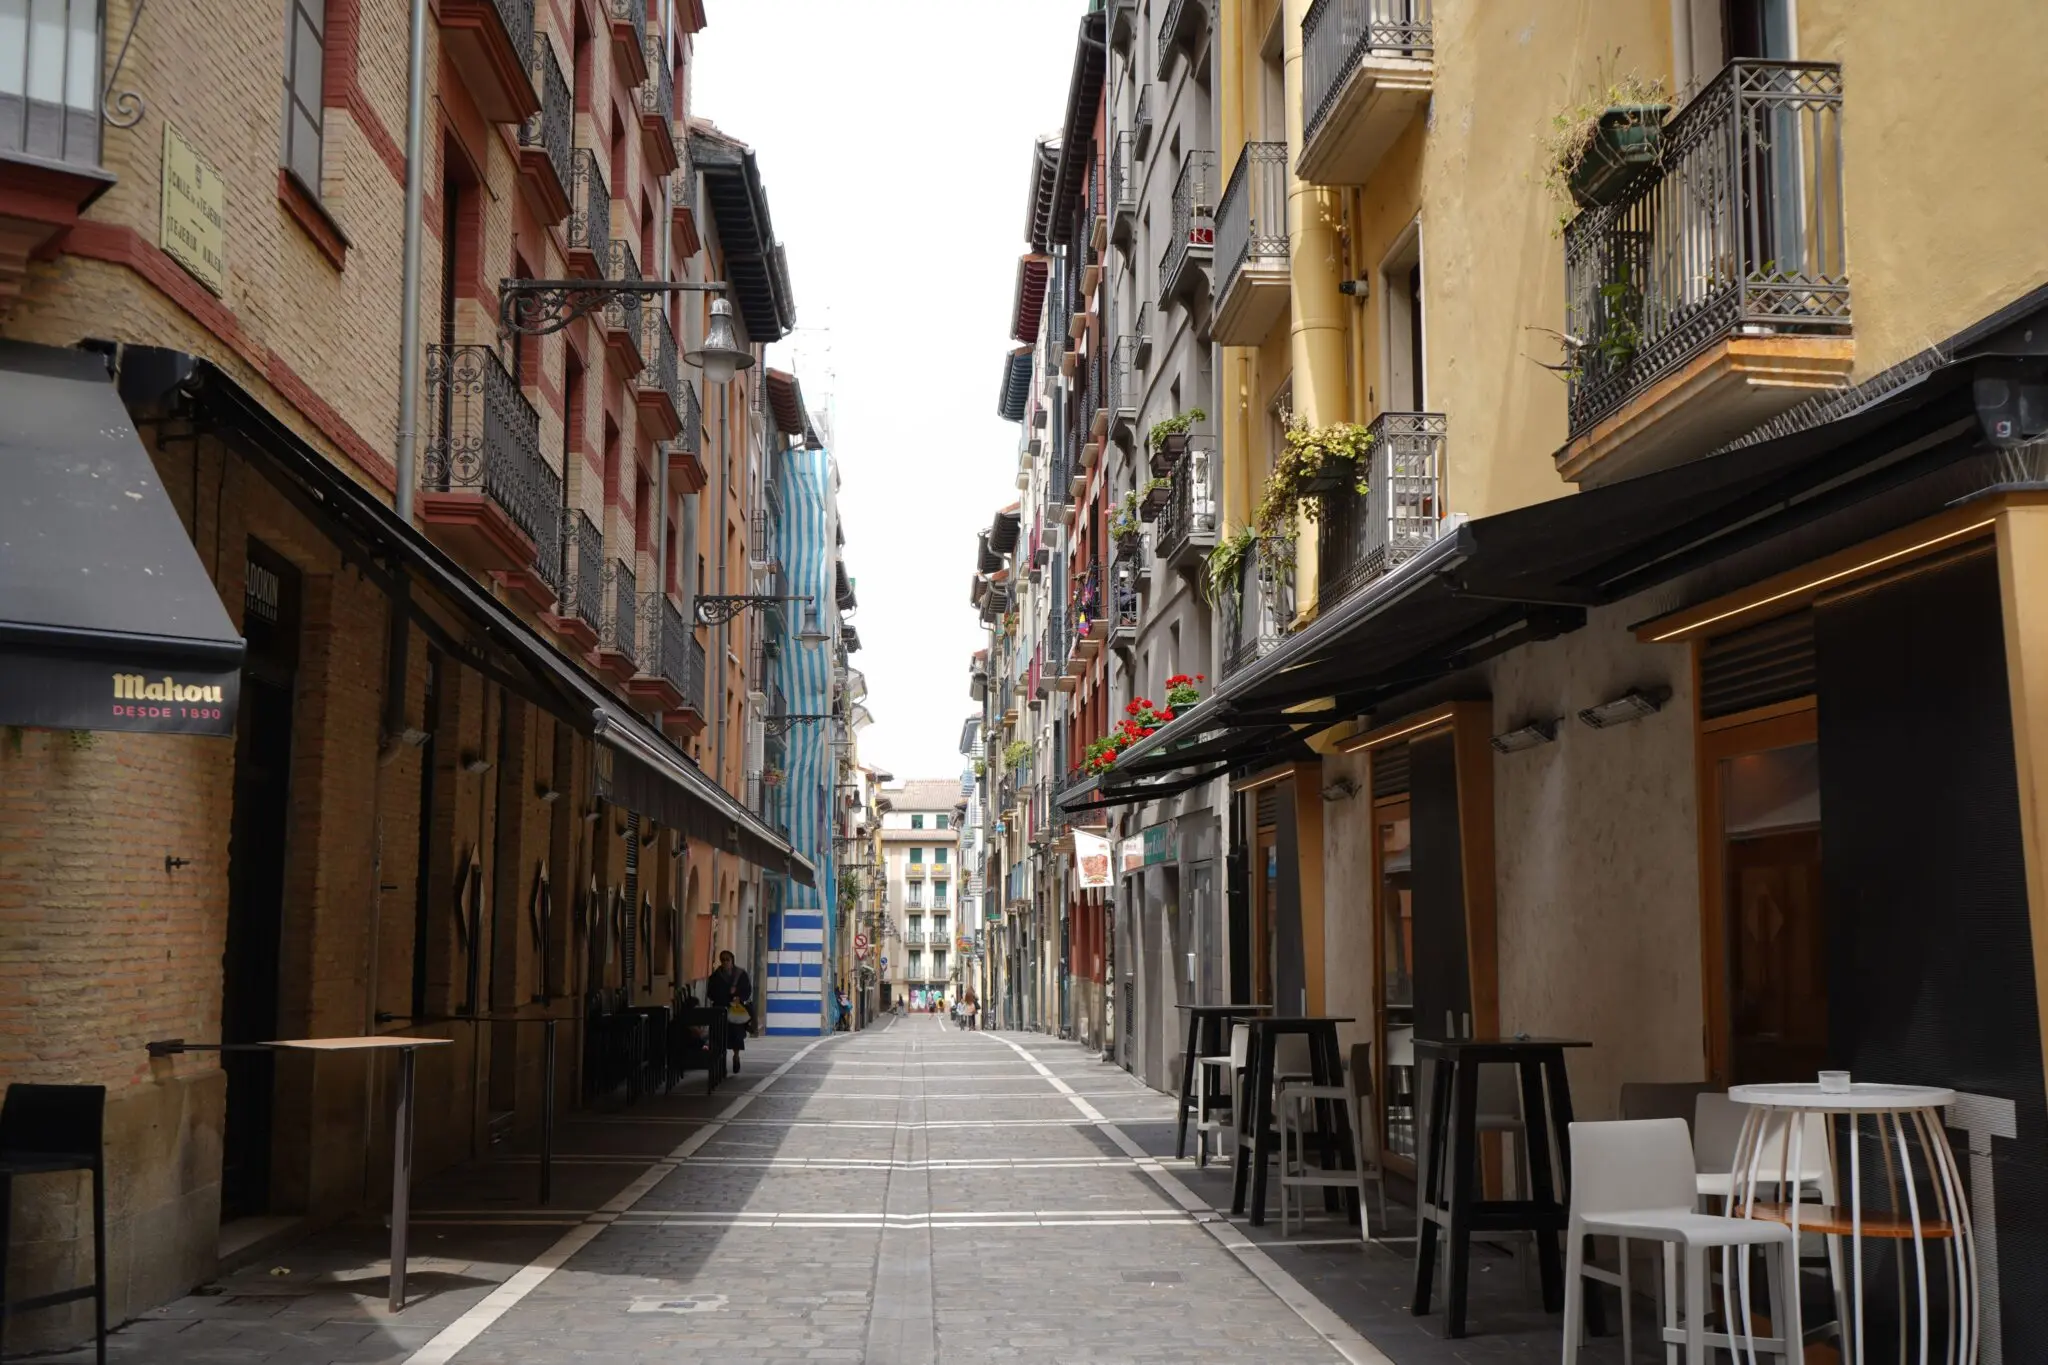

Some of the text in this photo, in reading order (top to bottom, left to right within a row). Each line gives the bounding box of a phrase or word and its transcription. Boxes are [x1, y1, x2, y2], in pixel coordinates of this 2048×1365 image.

[171, 170, 190, 201] CALLE
[112, 672, 223, 703] Mahou
[112, 705, 221, 720] DESDE 1890
